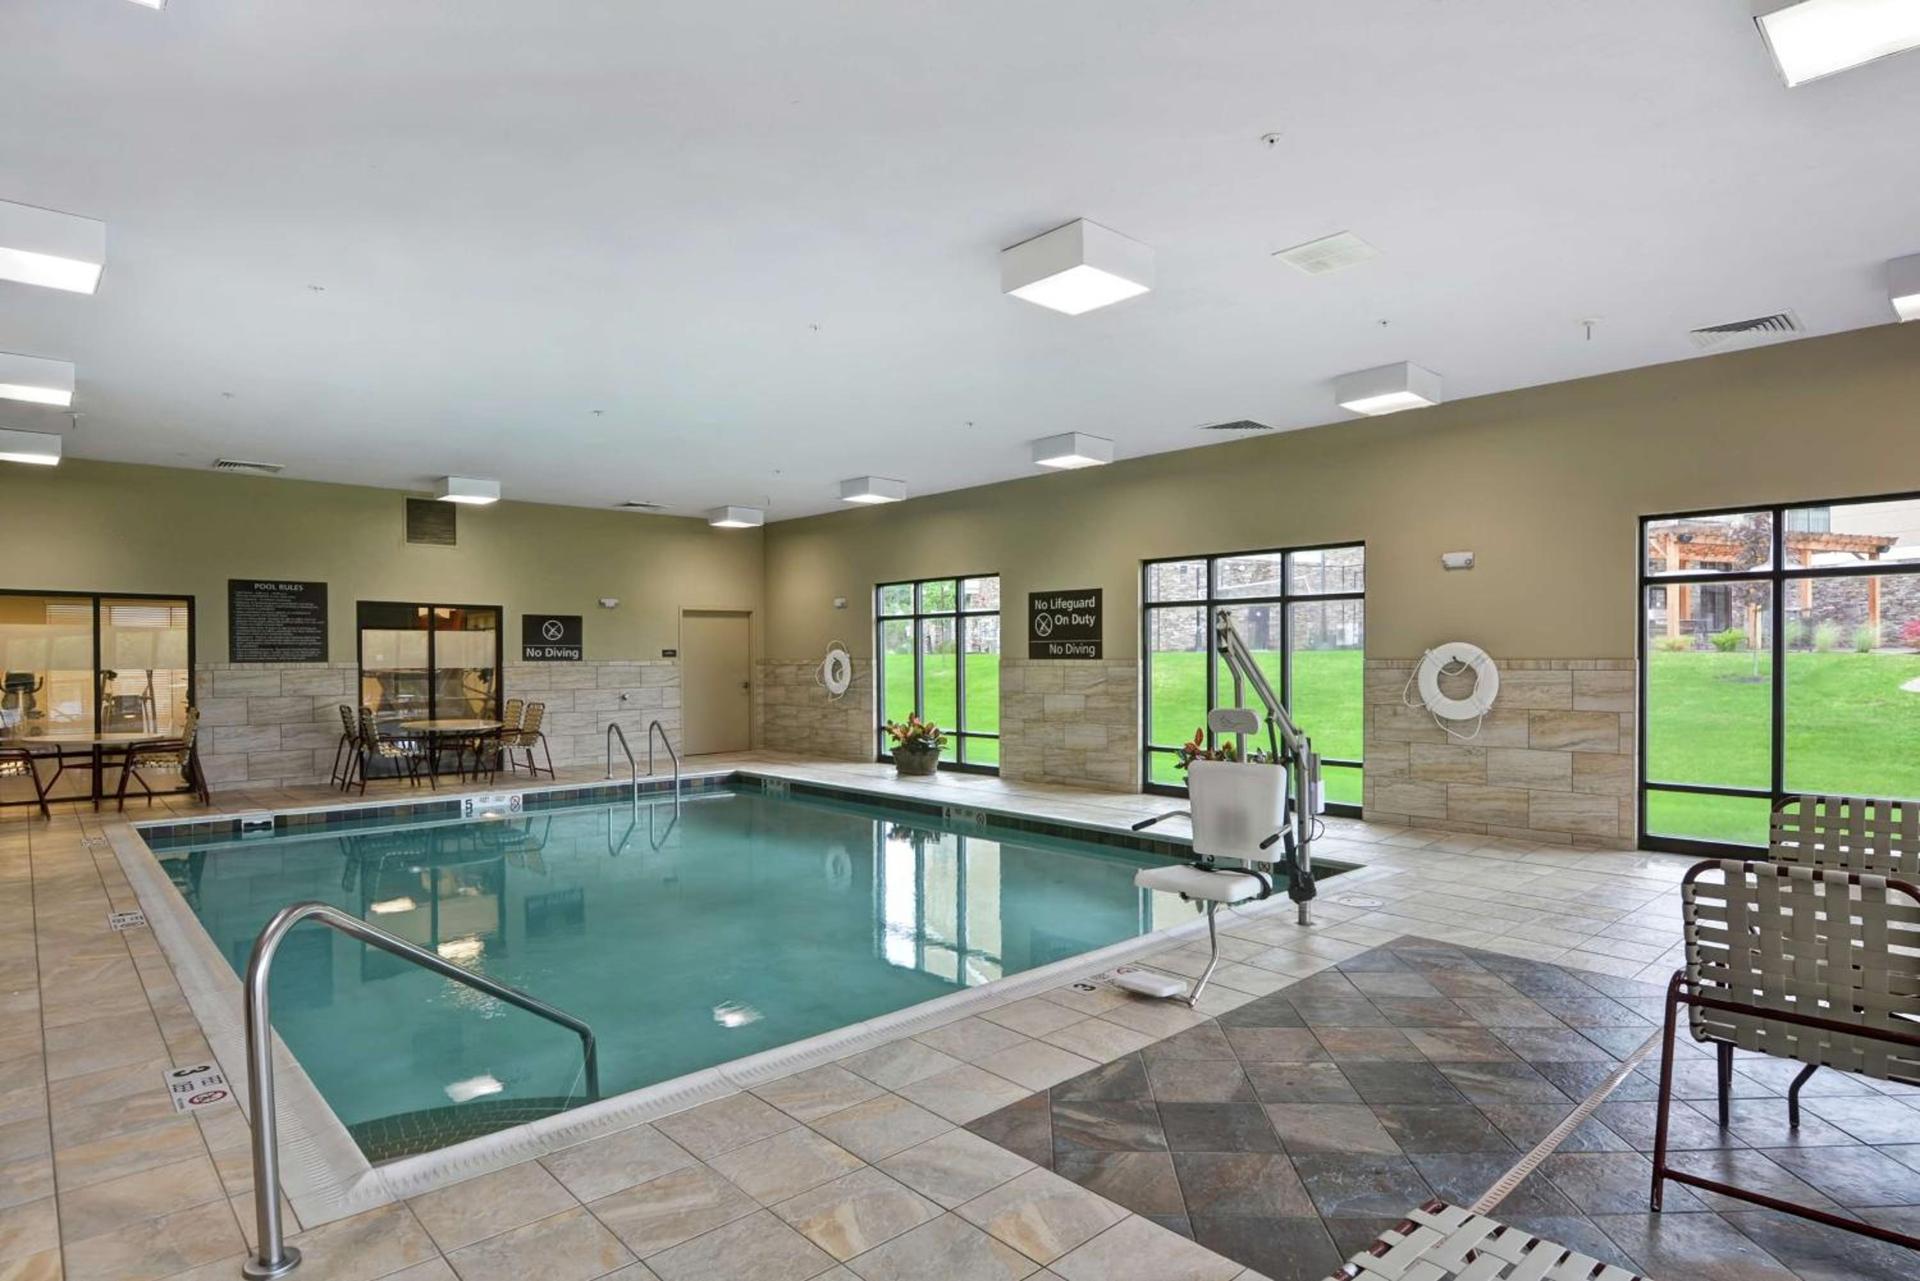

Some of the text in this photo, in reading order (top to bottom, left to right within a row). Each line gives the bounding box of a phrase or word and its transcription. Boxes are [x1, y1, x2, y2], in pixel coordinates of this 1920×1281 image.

[254, 583, 304, 592] POOL RULES
[1034, 595, 1096, 612] No Lifeguard
[1054, 613, 1096, 628] On Duty
[526, 647, 579, 660] No Diving
[1049, 642, 1096, 658] No Diving
